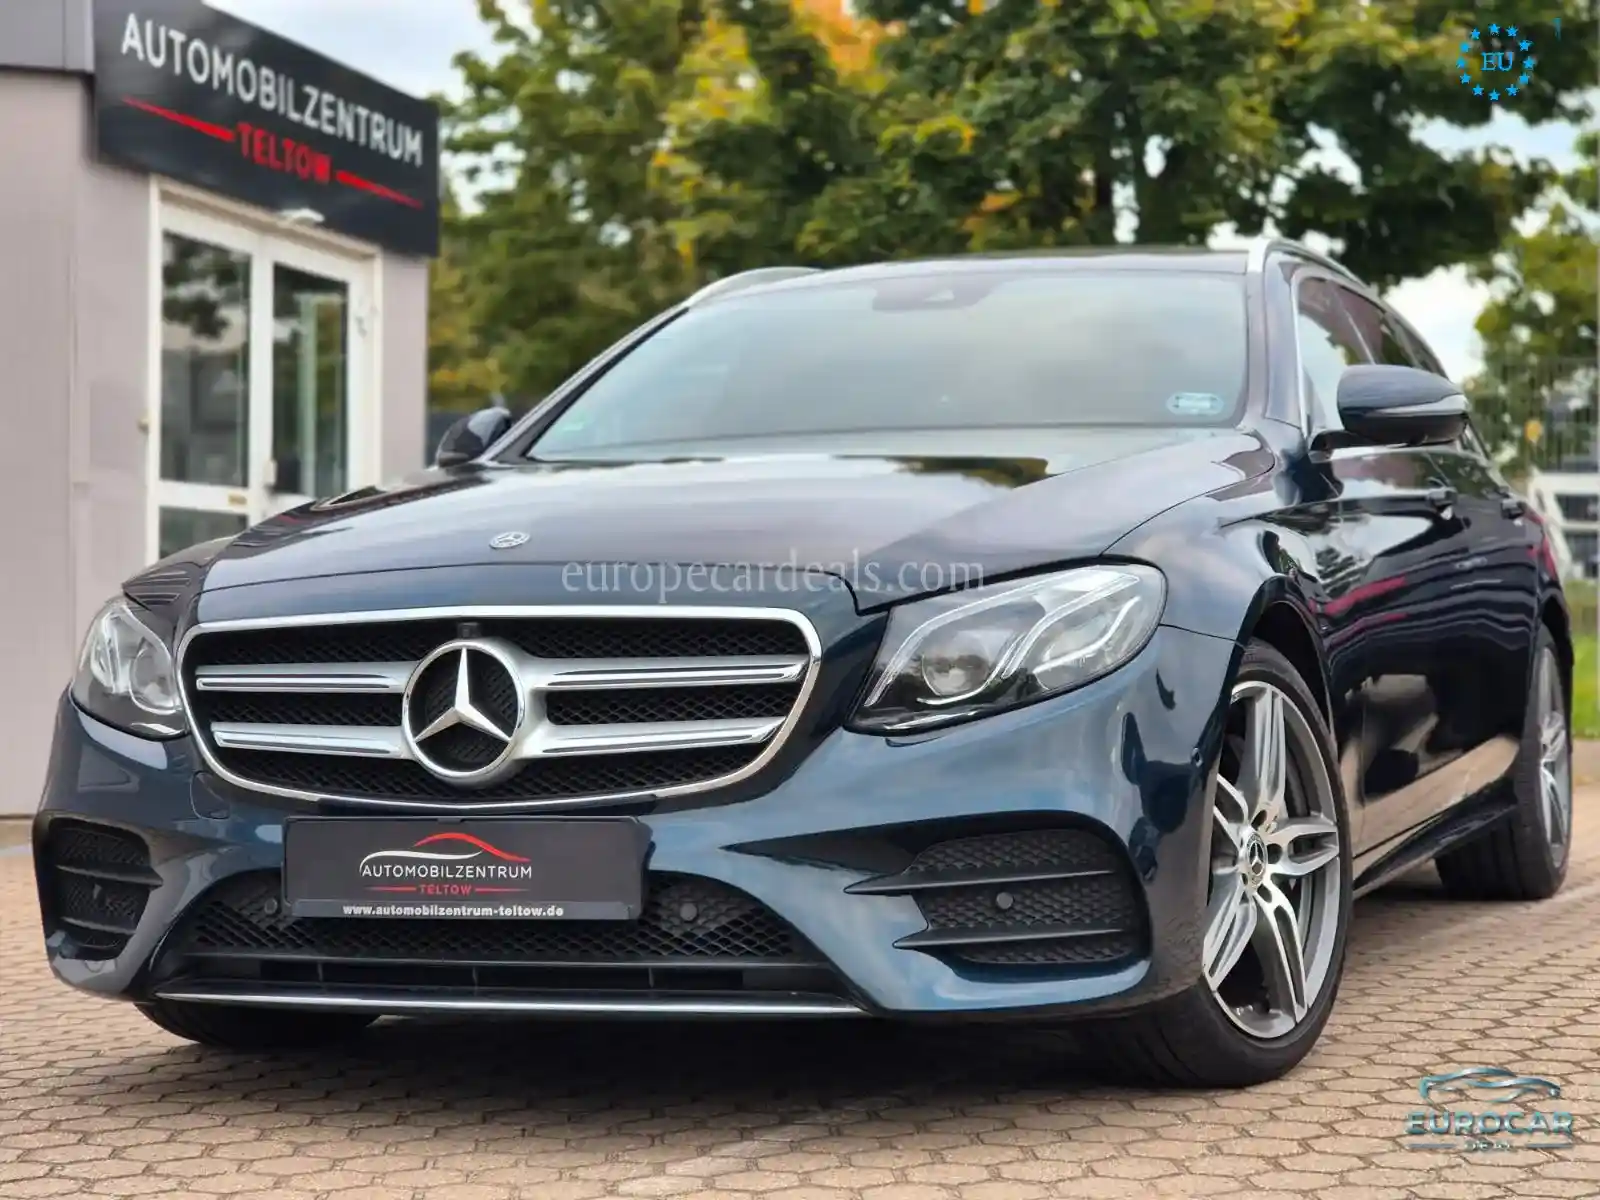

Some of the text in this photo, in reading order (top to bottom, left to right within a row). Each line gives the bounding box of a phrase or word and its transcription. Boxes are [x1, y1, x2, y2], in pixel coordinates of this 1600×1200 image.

[121, 13, 423, 168] AUTOMOBILZENTRUM
[237, 122, 332, 183] TELTOW
[362, 864, 532, 878] AUTOMOBILZENTRUM
[420, 884, 472, 895] TELTOW
[342, 904, 564, 917] www.automobilzentrum-teltow.de
